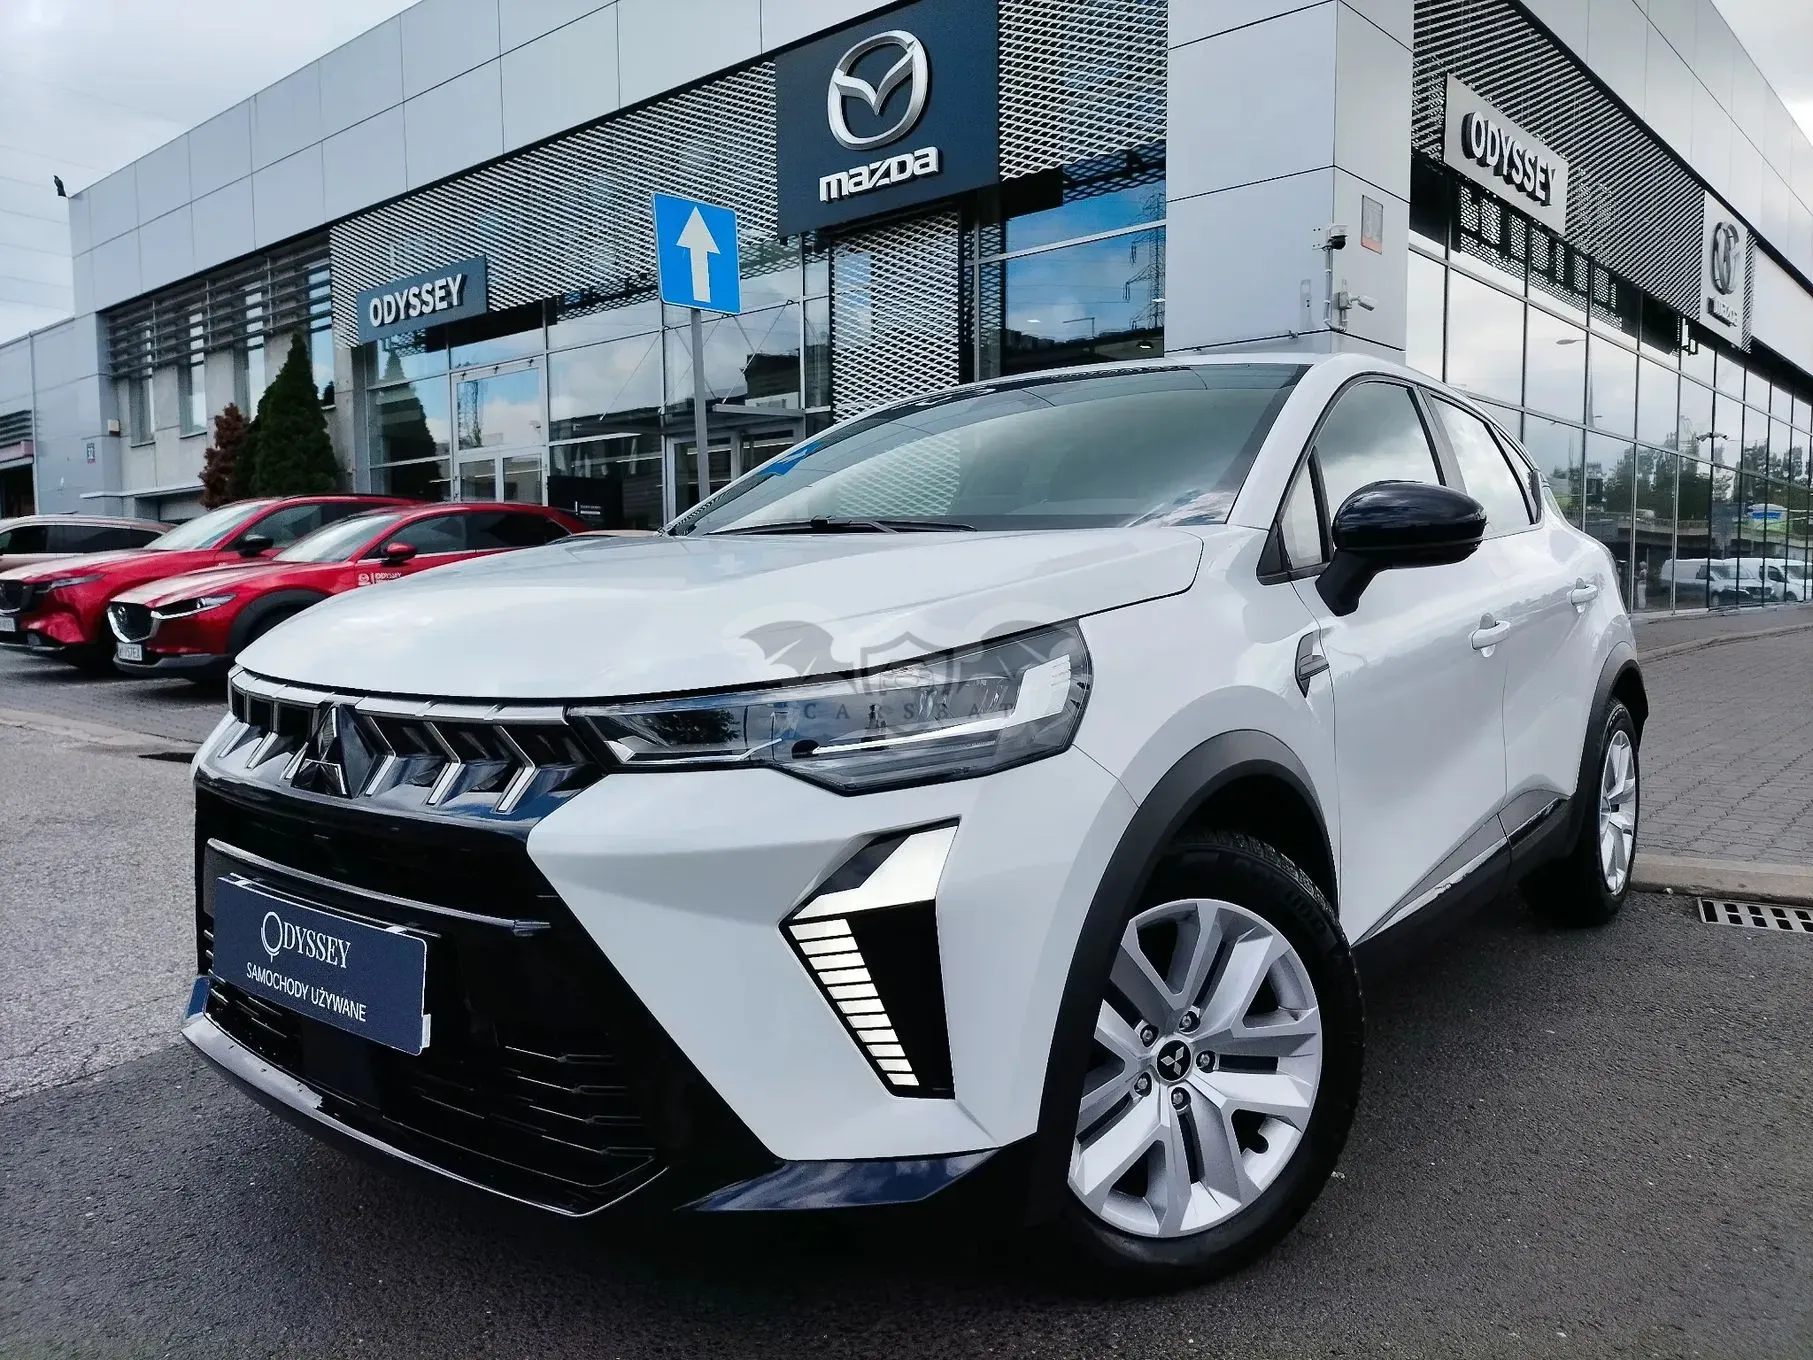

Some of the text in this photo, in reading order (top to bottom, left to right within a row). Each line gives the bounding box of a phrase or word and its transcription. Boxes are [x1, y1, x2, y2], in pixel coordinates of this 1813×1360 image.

[1462, 111, 1556, 206] ODYSSEY
[369, 273, 463, 328] ODYSSEY
[261, 911, 351, 969] ODYSSEY
[246, 962, 367, 1022] SAMOCHODY UŻYWANE
